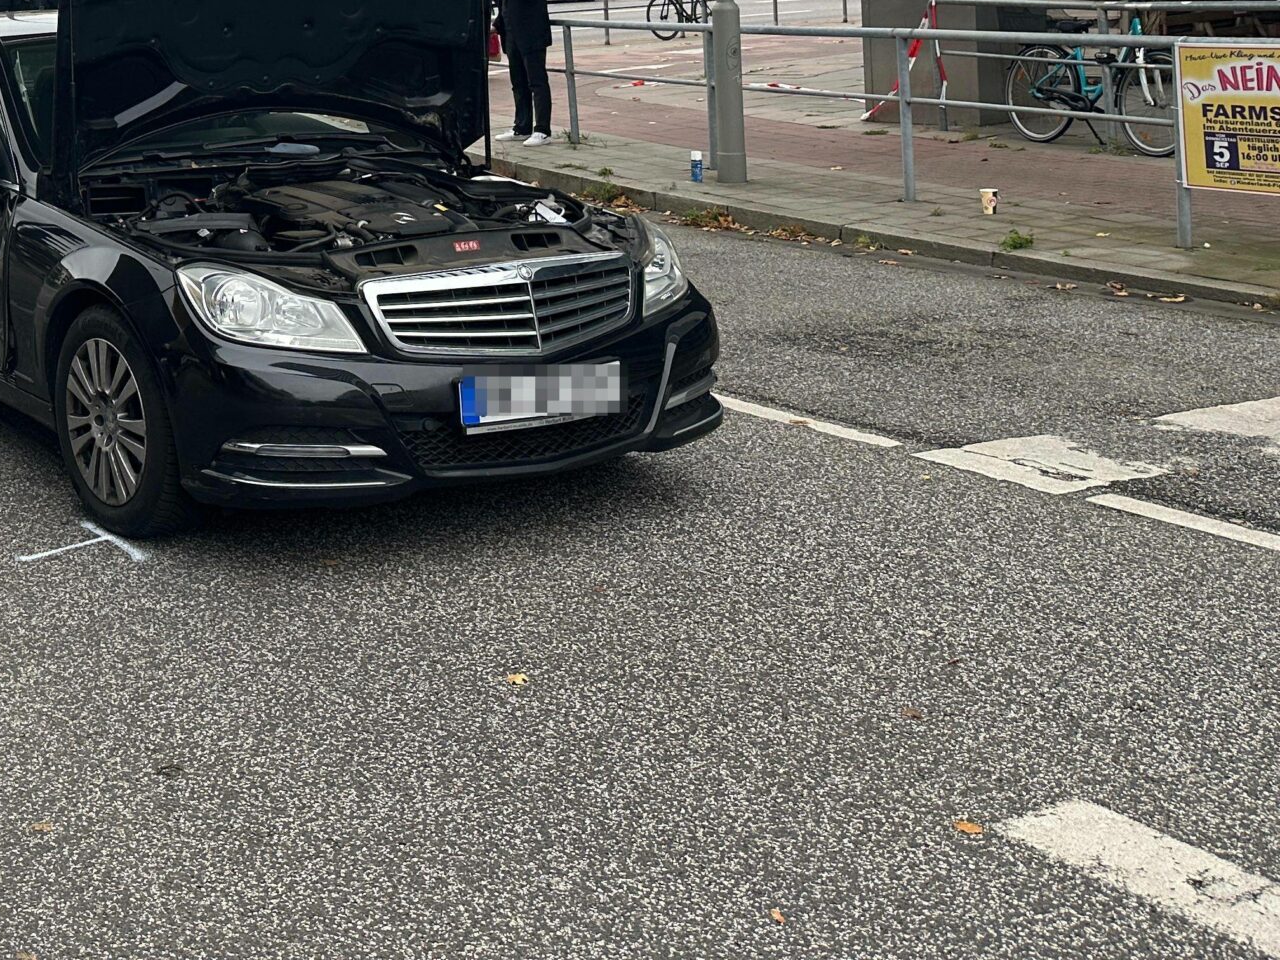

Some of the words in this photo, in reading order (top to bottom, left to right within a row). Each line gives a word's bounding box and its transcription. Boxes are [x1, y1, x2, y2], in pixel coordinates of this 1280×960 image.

[1229, 50, 1255, 60] Kling
[1256, 51, 1275, 59] und
[1183, 81, 1216, 101] Das
[1202, 123, 1216, 131] Im
[1213, 140, 1231, 163] 5
[1247, 143, 1280, 153] täglich
[1241, 152, 1269, 162] 16:00
